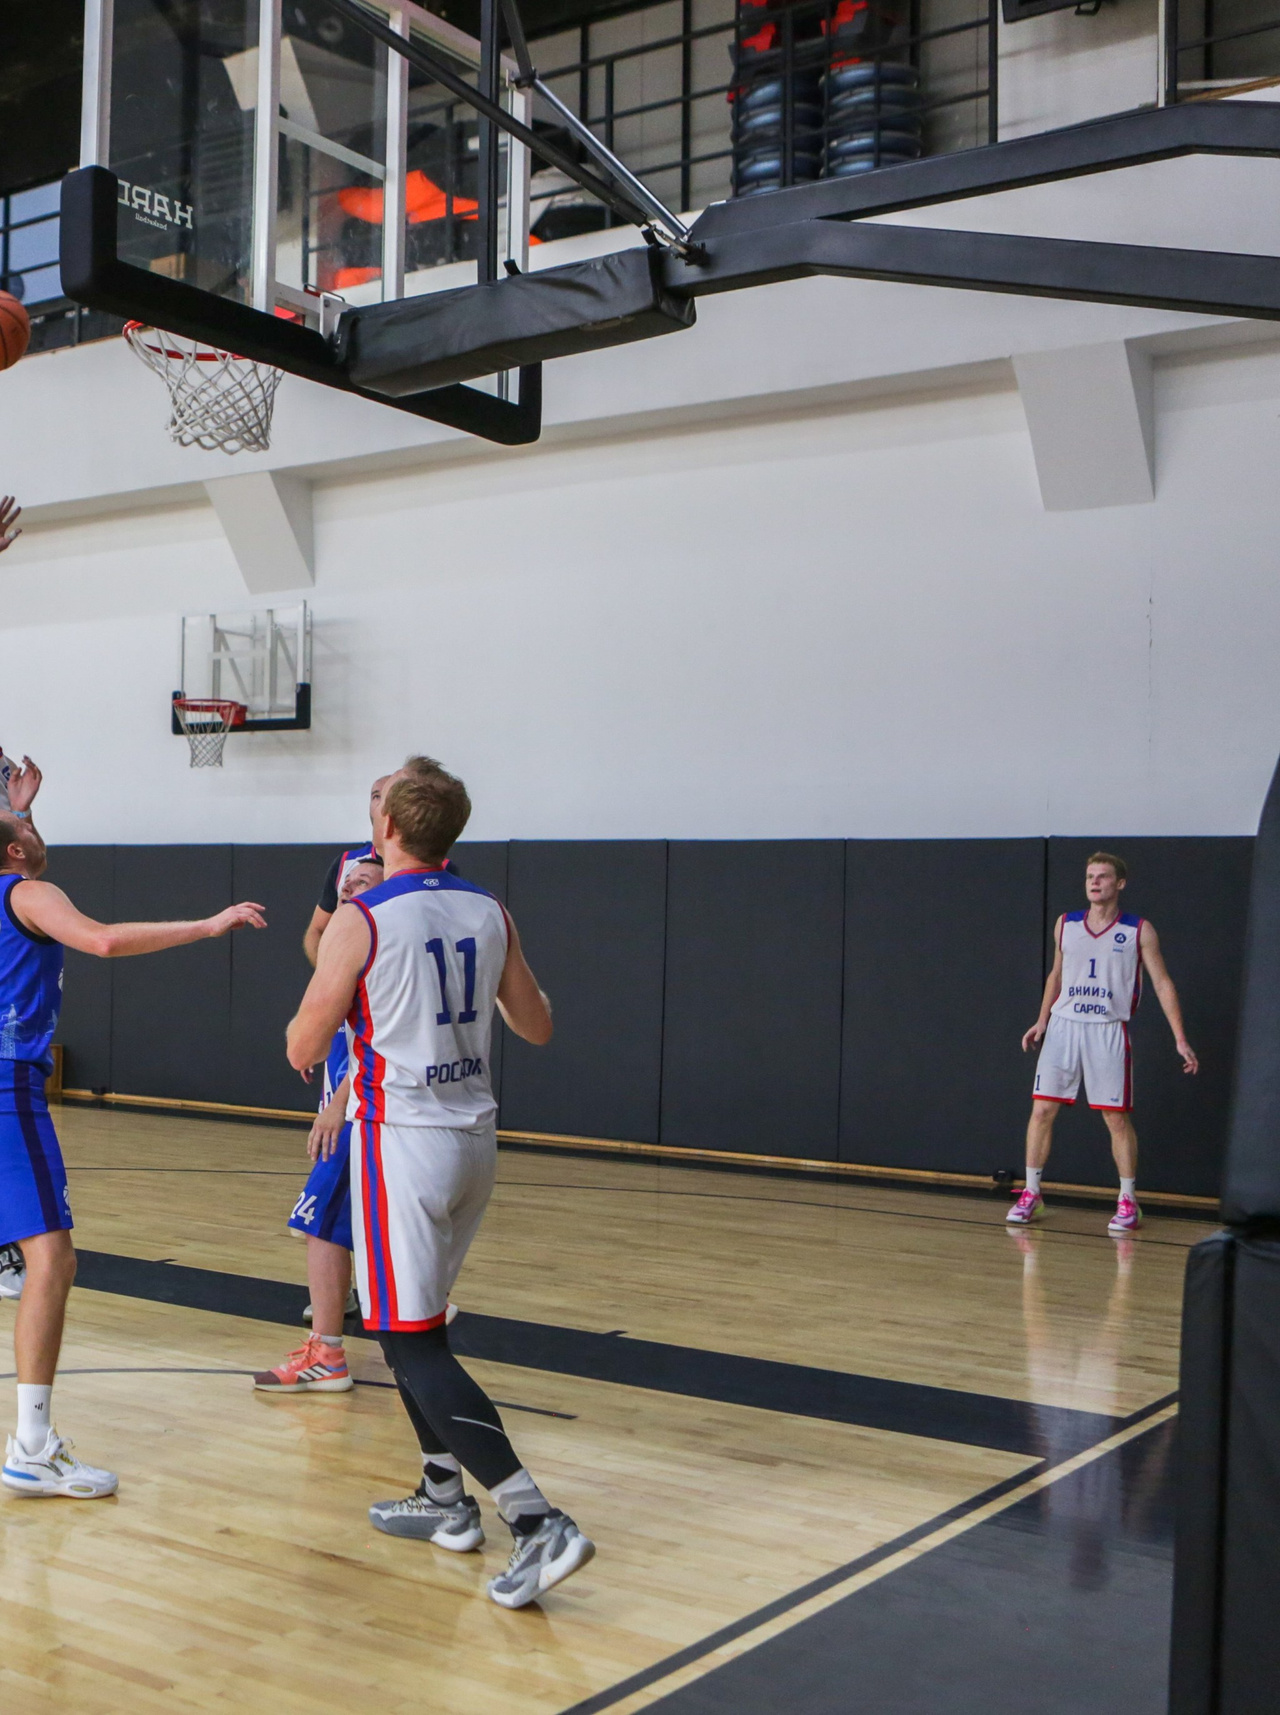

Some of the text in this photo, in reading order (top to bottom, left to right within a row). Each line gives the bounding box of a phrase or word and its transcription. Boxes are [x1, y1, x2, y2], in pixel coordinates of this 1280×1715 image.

[1088, 958, 1097, 978] 1
[425, 937, 478, 1026] 11
[1074, 1003, 1107, 1015] САРОВ
[1035, 1074, 1040, 1091] 1
[290, 1191, 318, 1225] 24
